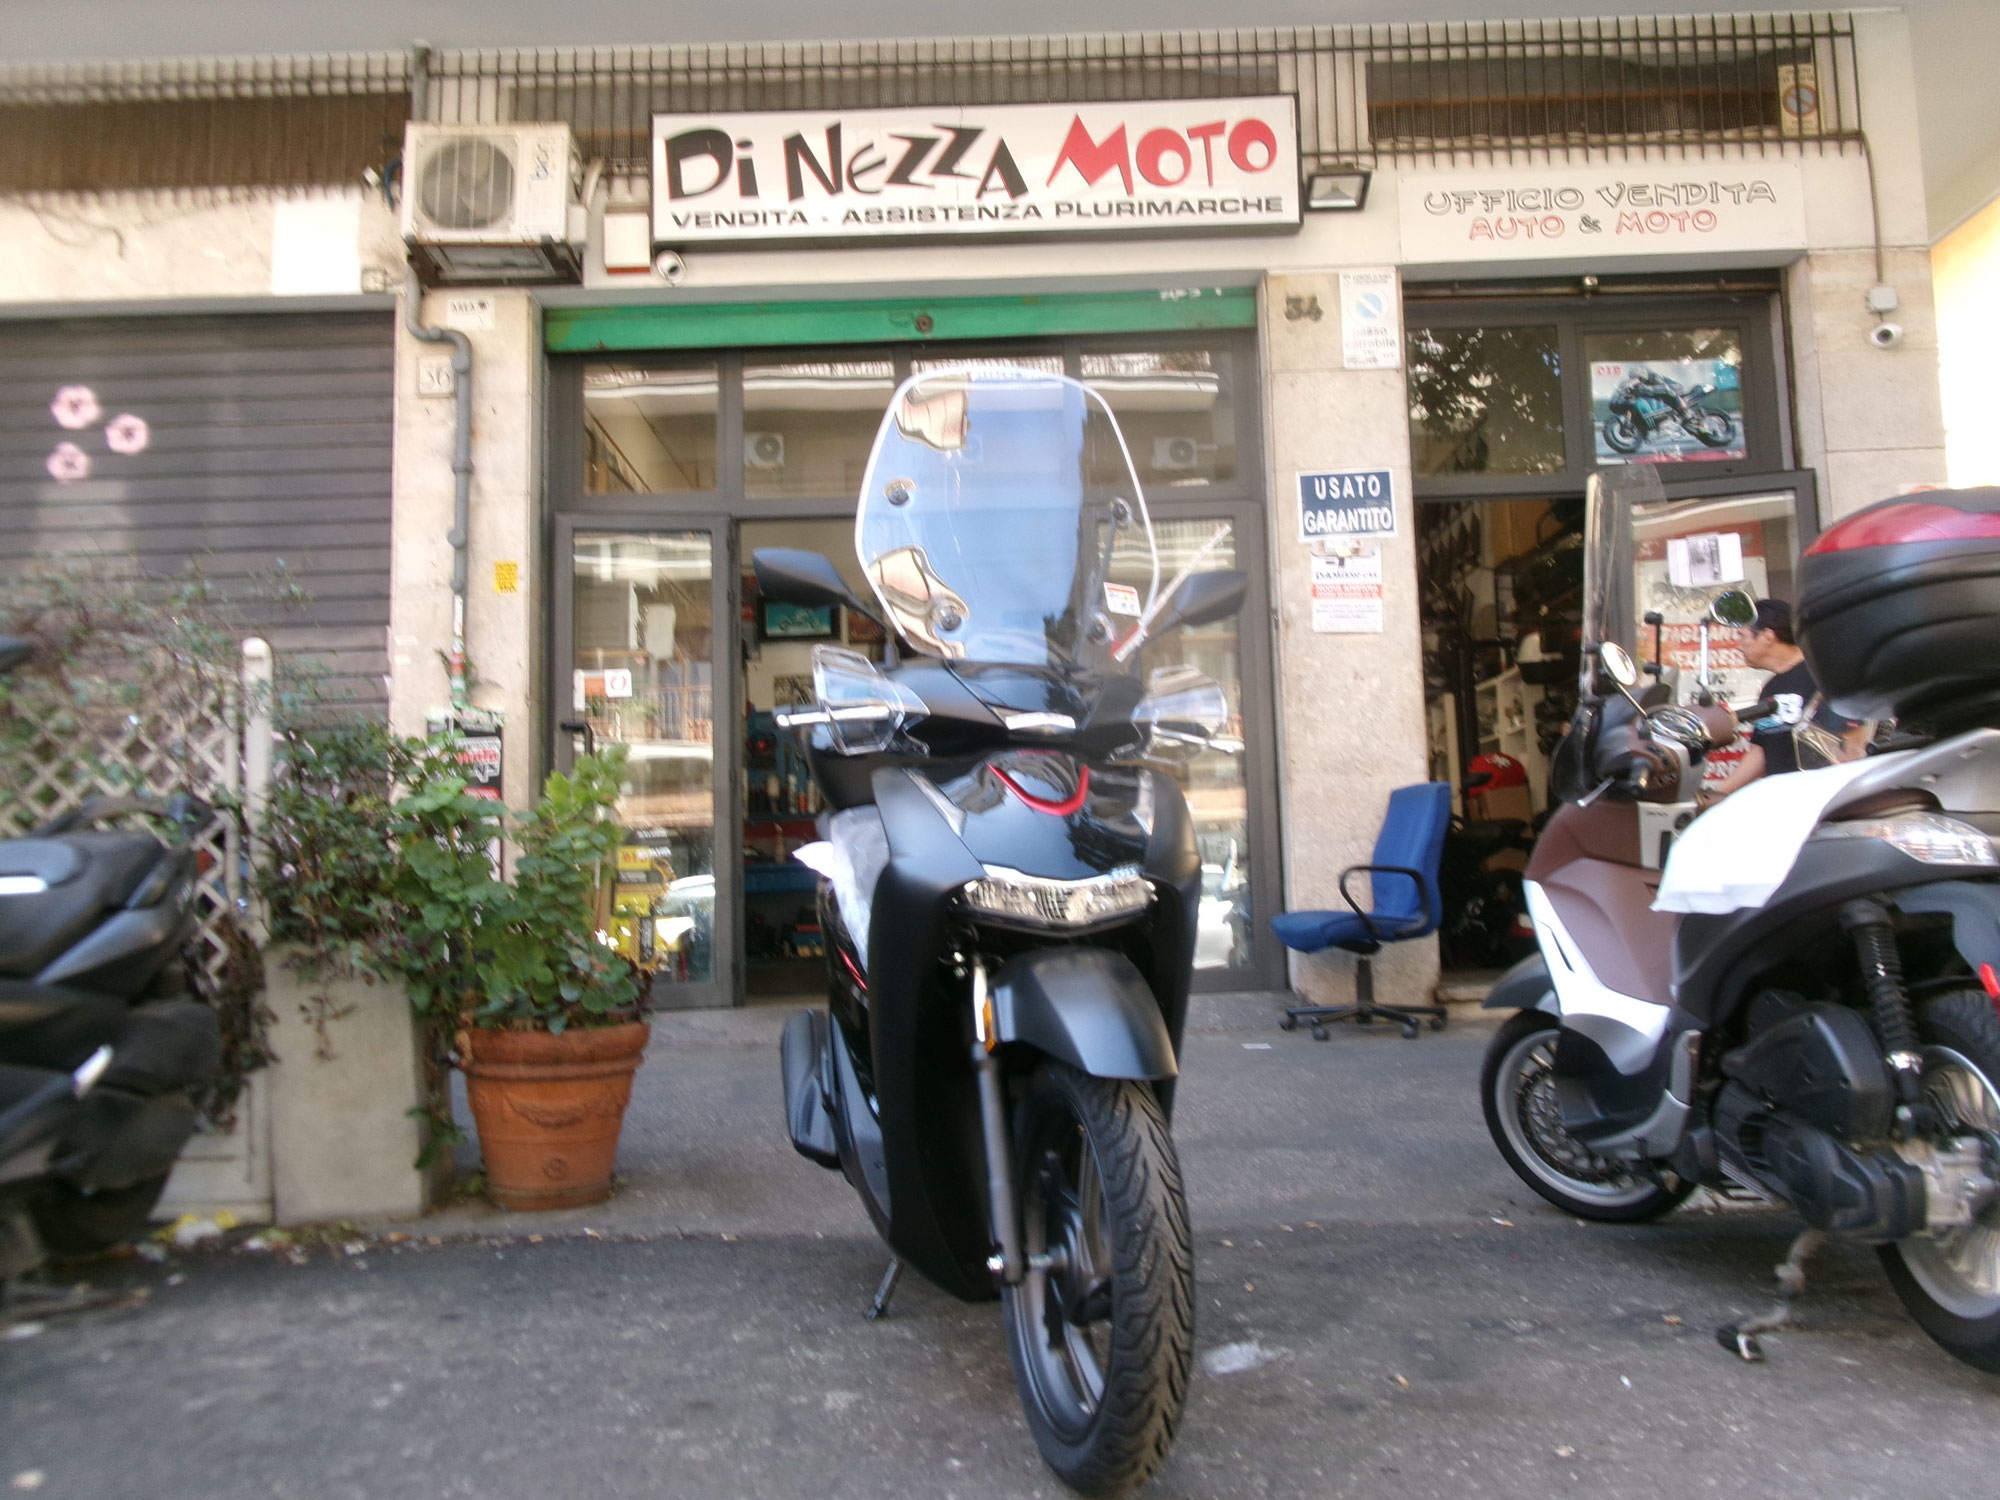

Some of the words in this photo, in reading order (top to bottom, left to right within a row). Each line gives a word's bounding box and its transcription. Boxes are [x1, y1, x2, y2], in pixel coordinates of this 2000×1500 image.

[1046, 112, 1278, 197] MOTO
[671, 208, 810, 230] VENDITA
[842, 201, 1043, 226] ASSISTENZA
[1054, 196, 1284, 219] PLURIMARCHE
[1424, 187, 1585, 216] UFFICIO
[1596, 180, 1778, 210] VENDITA
[1469, 214, 1566, 242] AUTO
[1578, 213, 1603, 235] &
[1614, 208, 1718, 235] MOTO
[1314, 474, 1380, 499] USATO
[1304, 508, 1391, 532] GARANTITO
